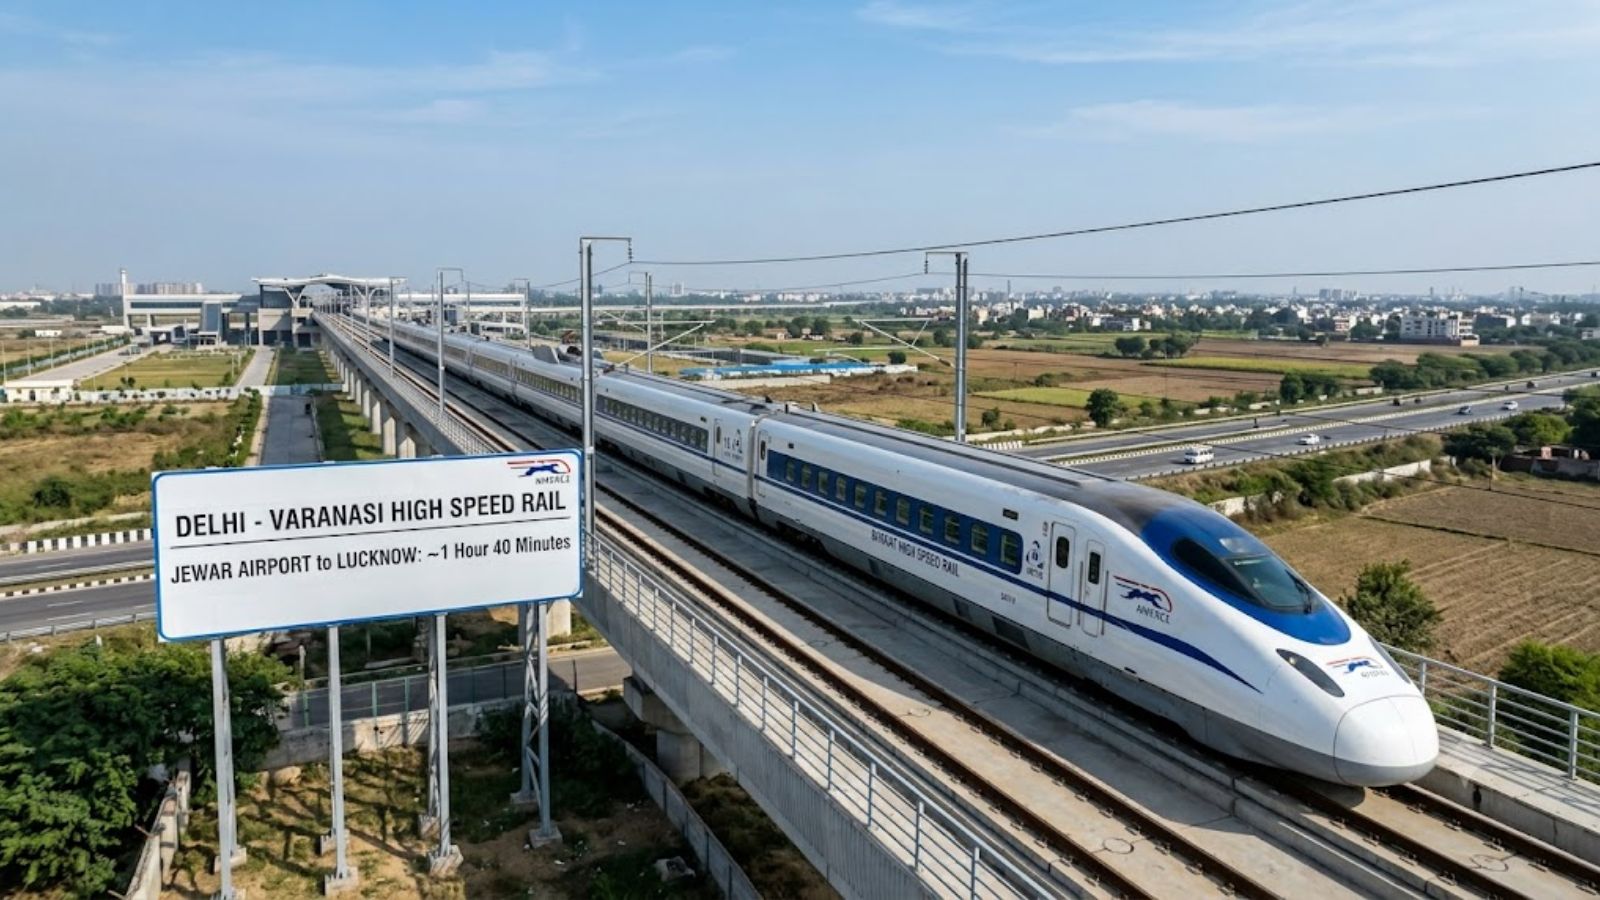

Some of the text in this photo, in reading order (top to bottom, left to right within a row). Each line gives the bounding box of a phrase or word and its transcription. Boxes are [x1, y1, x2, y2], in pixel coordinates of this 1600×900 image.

[176, 511, 246, 538] DELHI
[269, 502, 384, 531] VARANASI
[391, 498, 443, 522] HIGH
[450, 494, 515, 519] SPEED
[522, 490, 567, 513] RAIL
[171, 562, 233, 584] JEWAR
[238, 555, 312, 578] AIRPORT
[316, 554, 332, 571] to
[337, 546, 422, 569] LUCKNOW:
[454, 541, 489, 559] Hour
[493, 538, 511, 555] 40
[515, 534, 571, 553] Minutes
